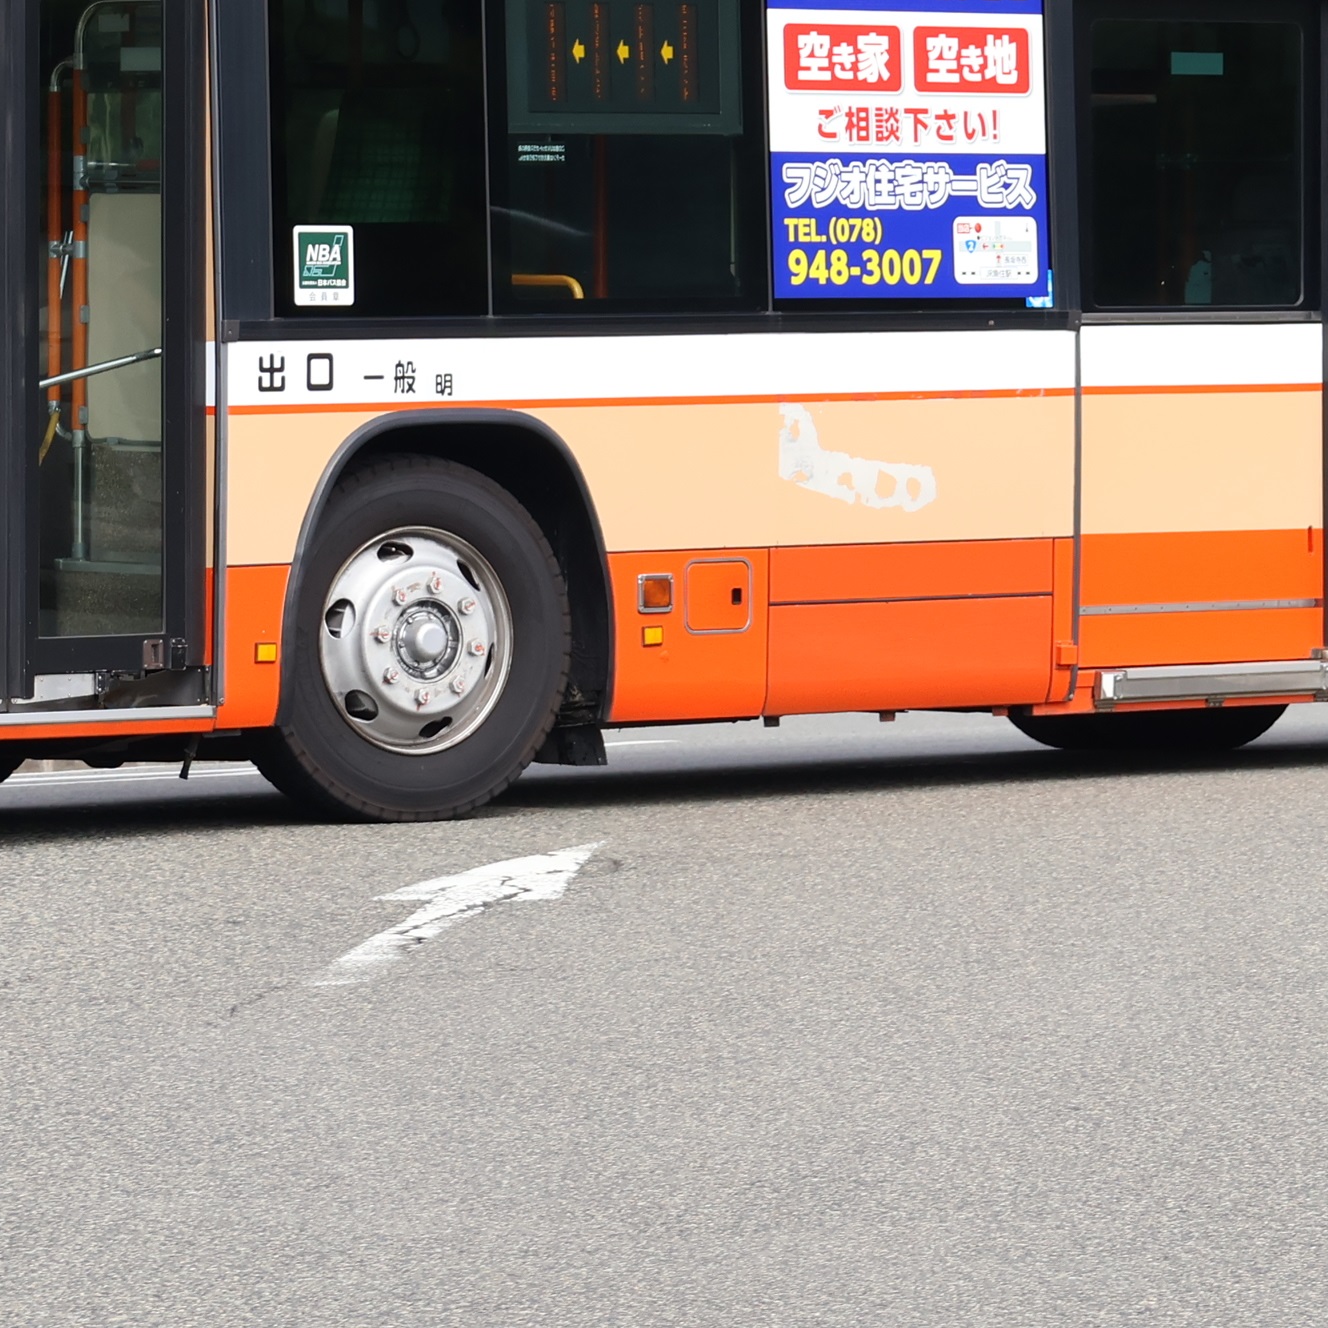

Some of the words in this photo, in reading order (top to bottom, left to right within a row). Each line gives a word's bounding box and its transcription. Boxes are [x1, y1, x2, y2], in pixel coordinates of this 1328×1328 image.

[797, 30, 890, 84] 空き家
[926, 33, 1018, 86] 空き地
[817, 105, 998, 143] ご相談下さい!
[782, 158, 1037, 210] フジオ住宅サービス
[306, 243, 341, 262] NBA
[788, 248, 942, 285] 948-3007
[258, 352, 334, 392] 出口
[363, 360, 417, 394] 一般
[435, 373, 453, 396] 明
